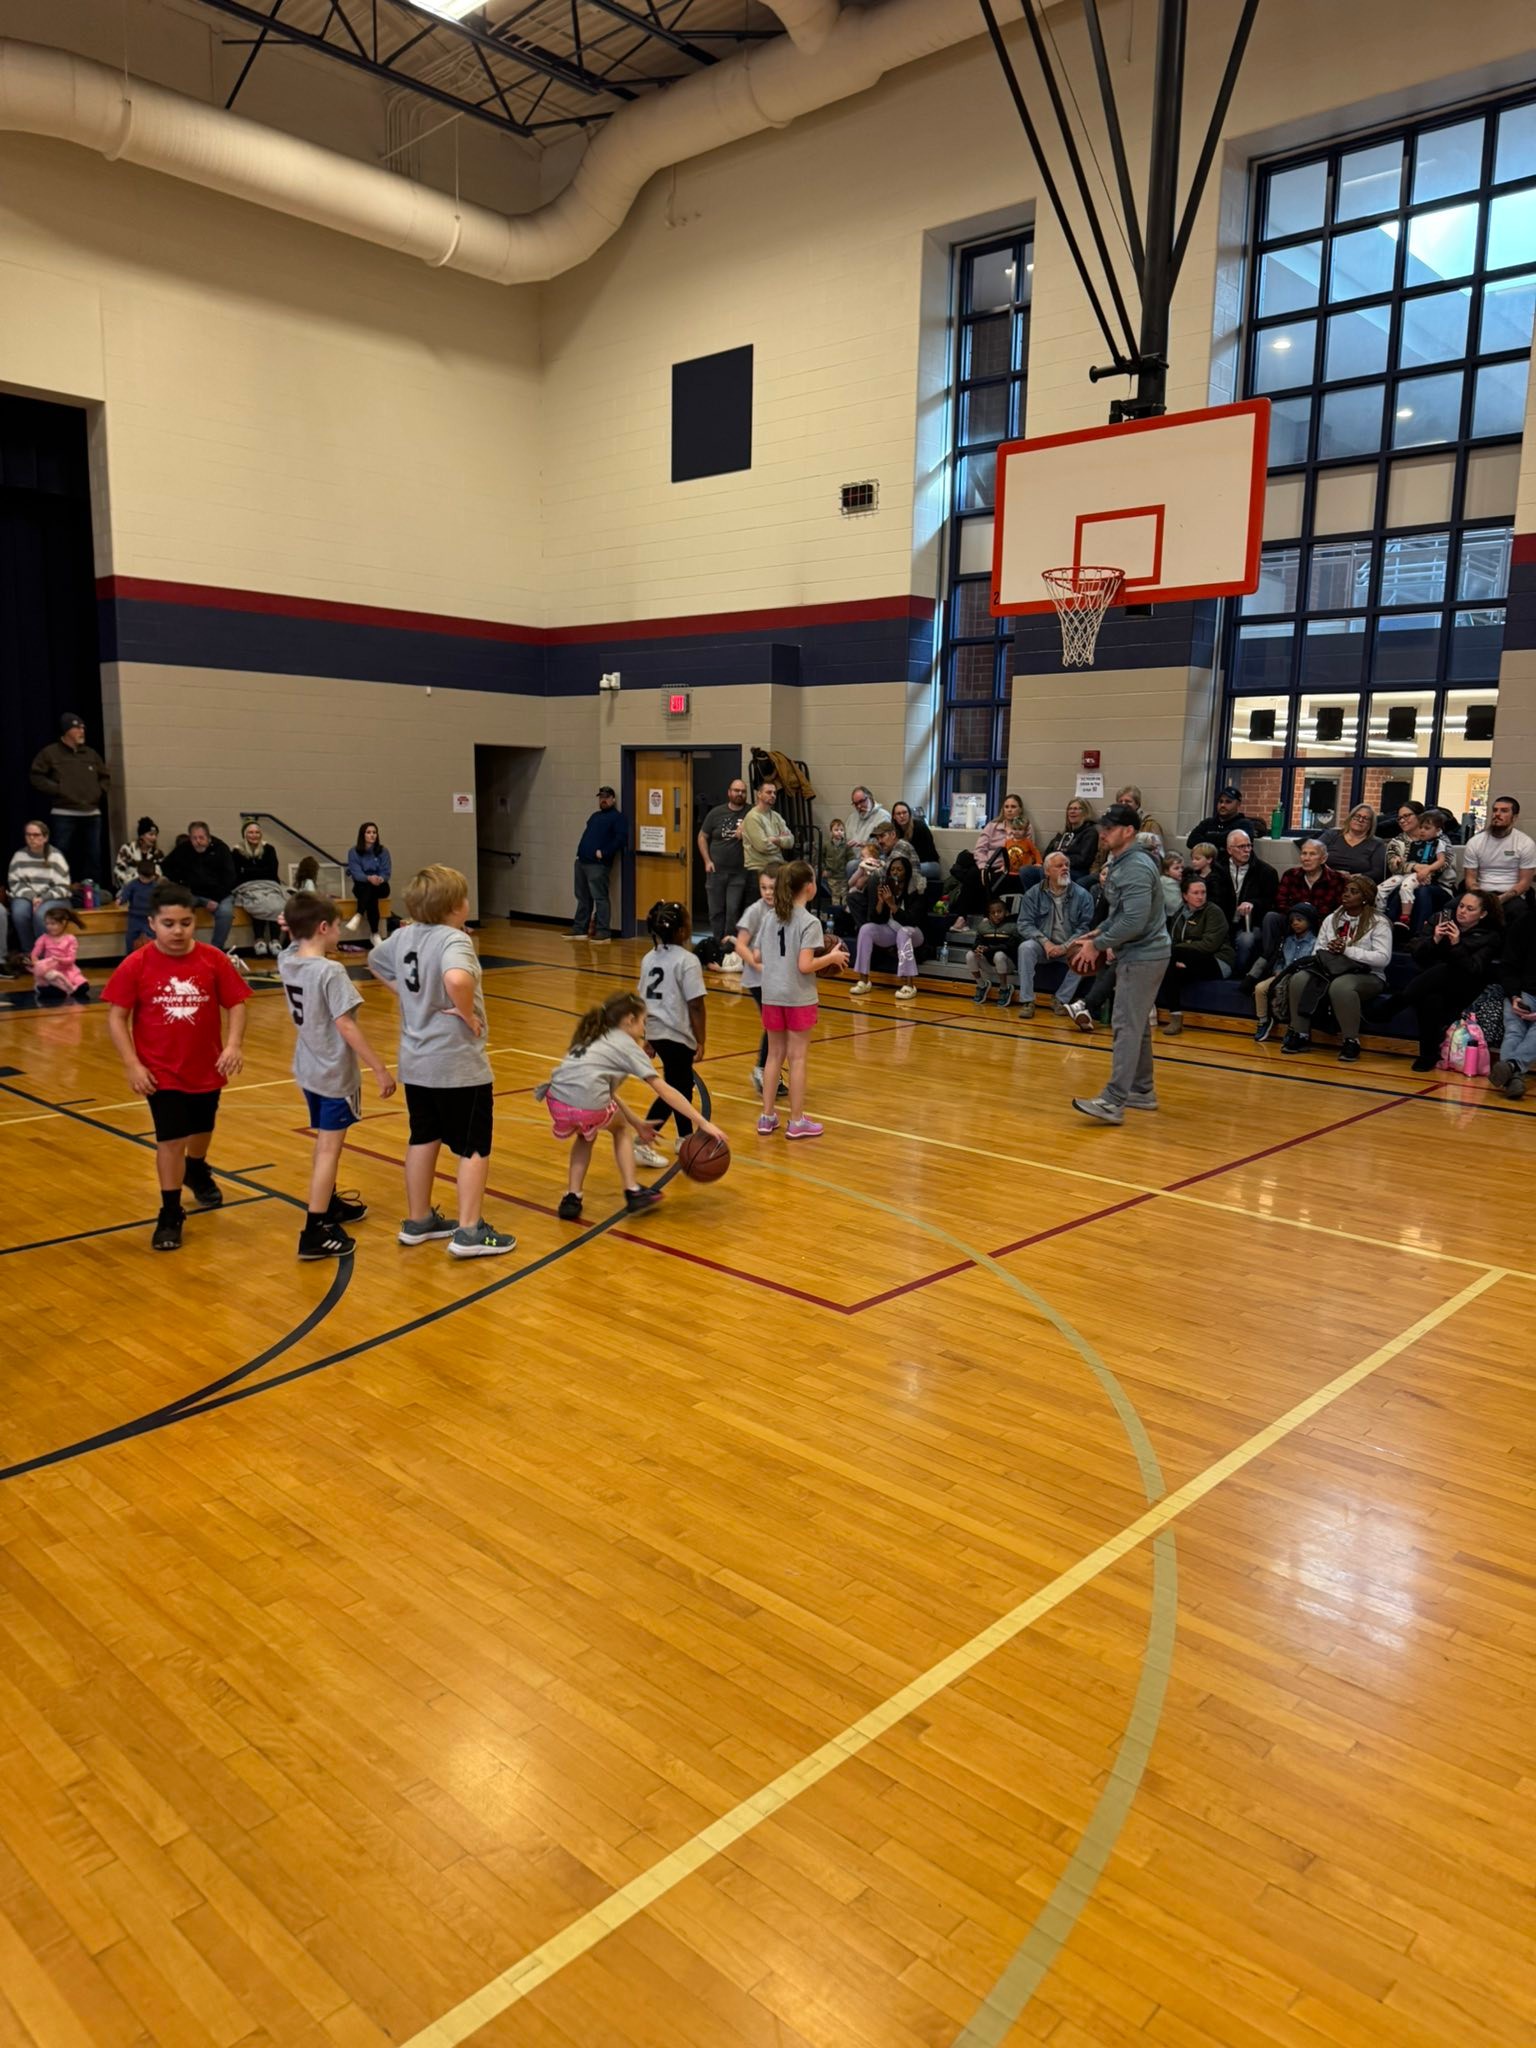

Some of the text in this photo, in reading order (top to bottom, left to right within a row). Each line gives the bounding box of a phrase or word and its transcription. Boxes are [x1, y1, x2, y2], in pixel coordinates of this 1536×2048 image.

[777, 926, 786, 957] 1
[403, 951, 421, 993] 3
[646, 966, 665, 1000] 2
[285, 984, 304, 1026] 5
